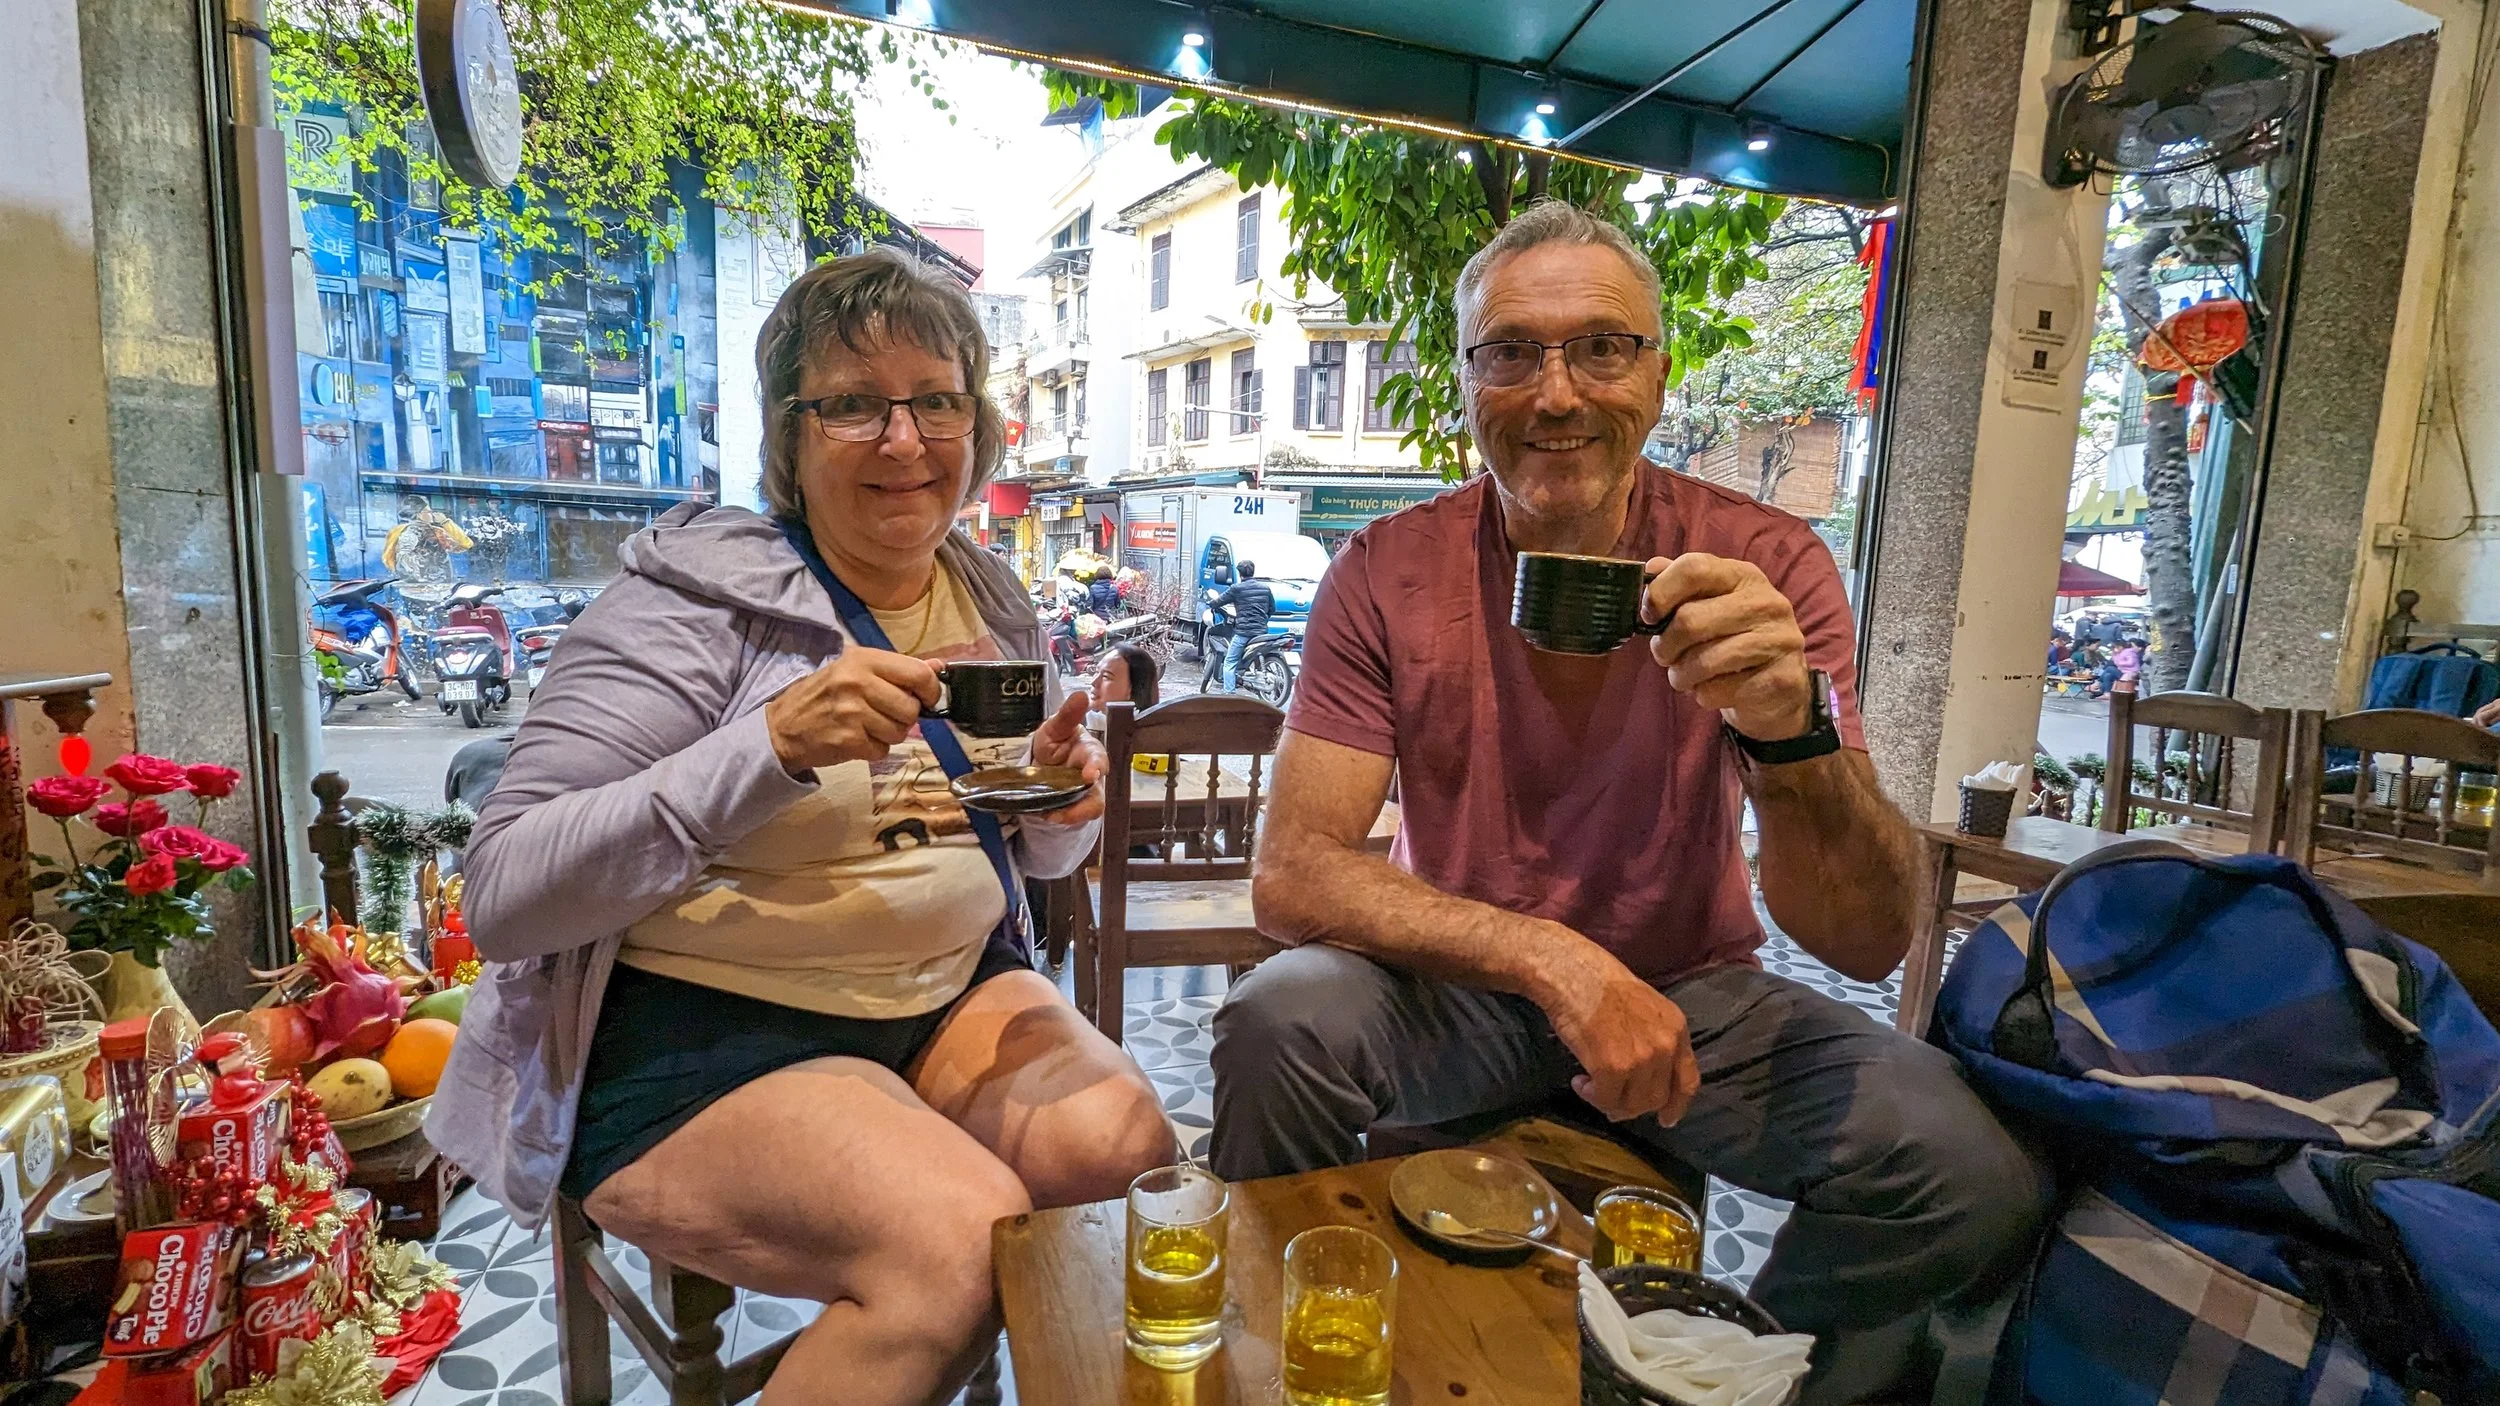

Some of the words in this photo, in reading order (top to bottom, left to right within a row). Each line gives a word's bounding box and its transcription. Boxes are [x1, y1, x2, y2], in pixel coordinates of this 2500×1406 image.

[1233, 496, 1264, 515] 24H
[1349, 497, 1378, 512] THỰC
[212, 1119, 236, 1178] Choc
[143, 1234, 185, 1345] ChocoPie
[185, 1232, 219, 1340] ChocoPie
